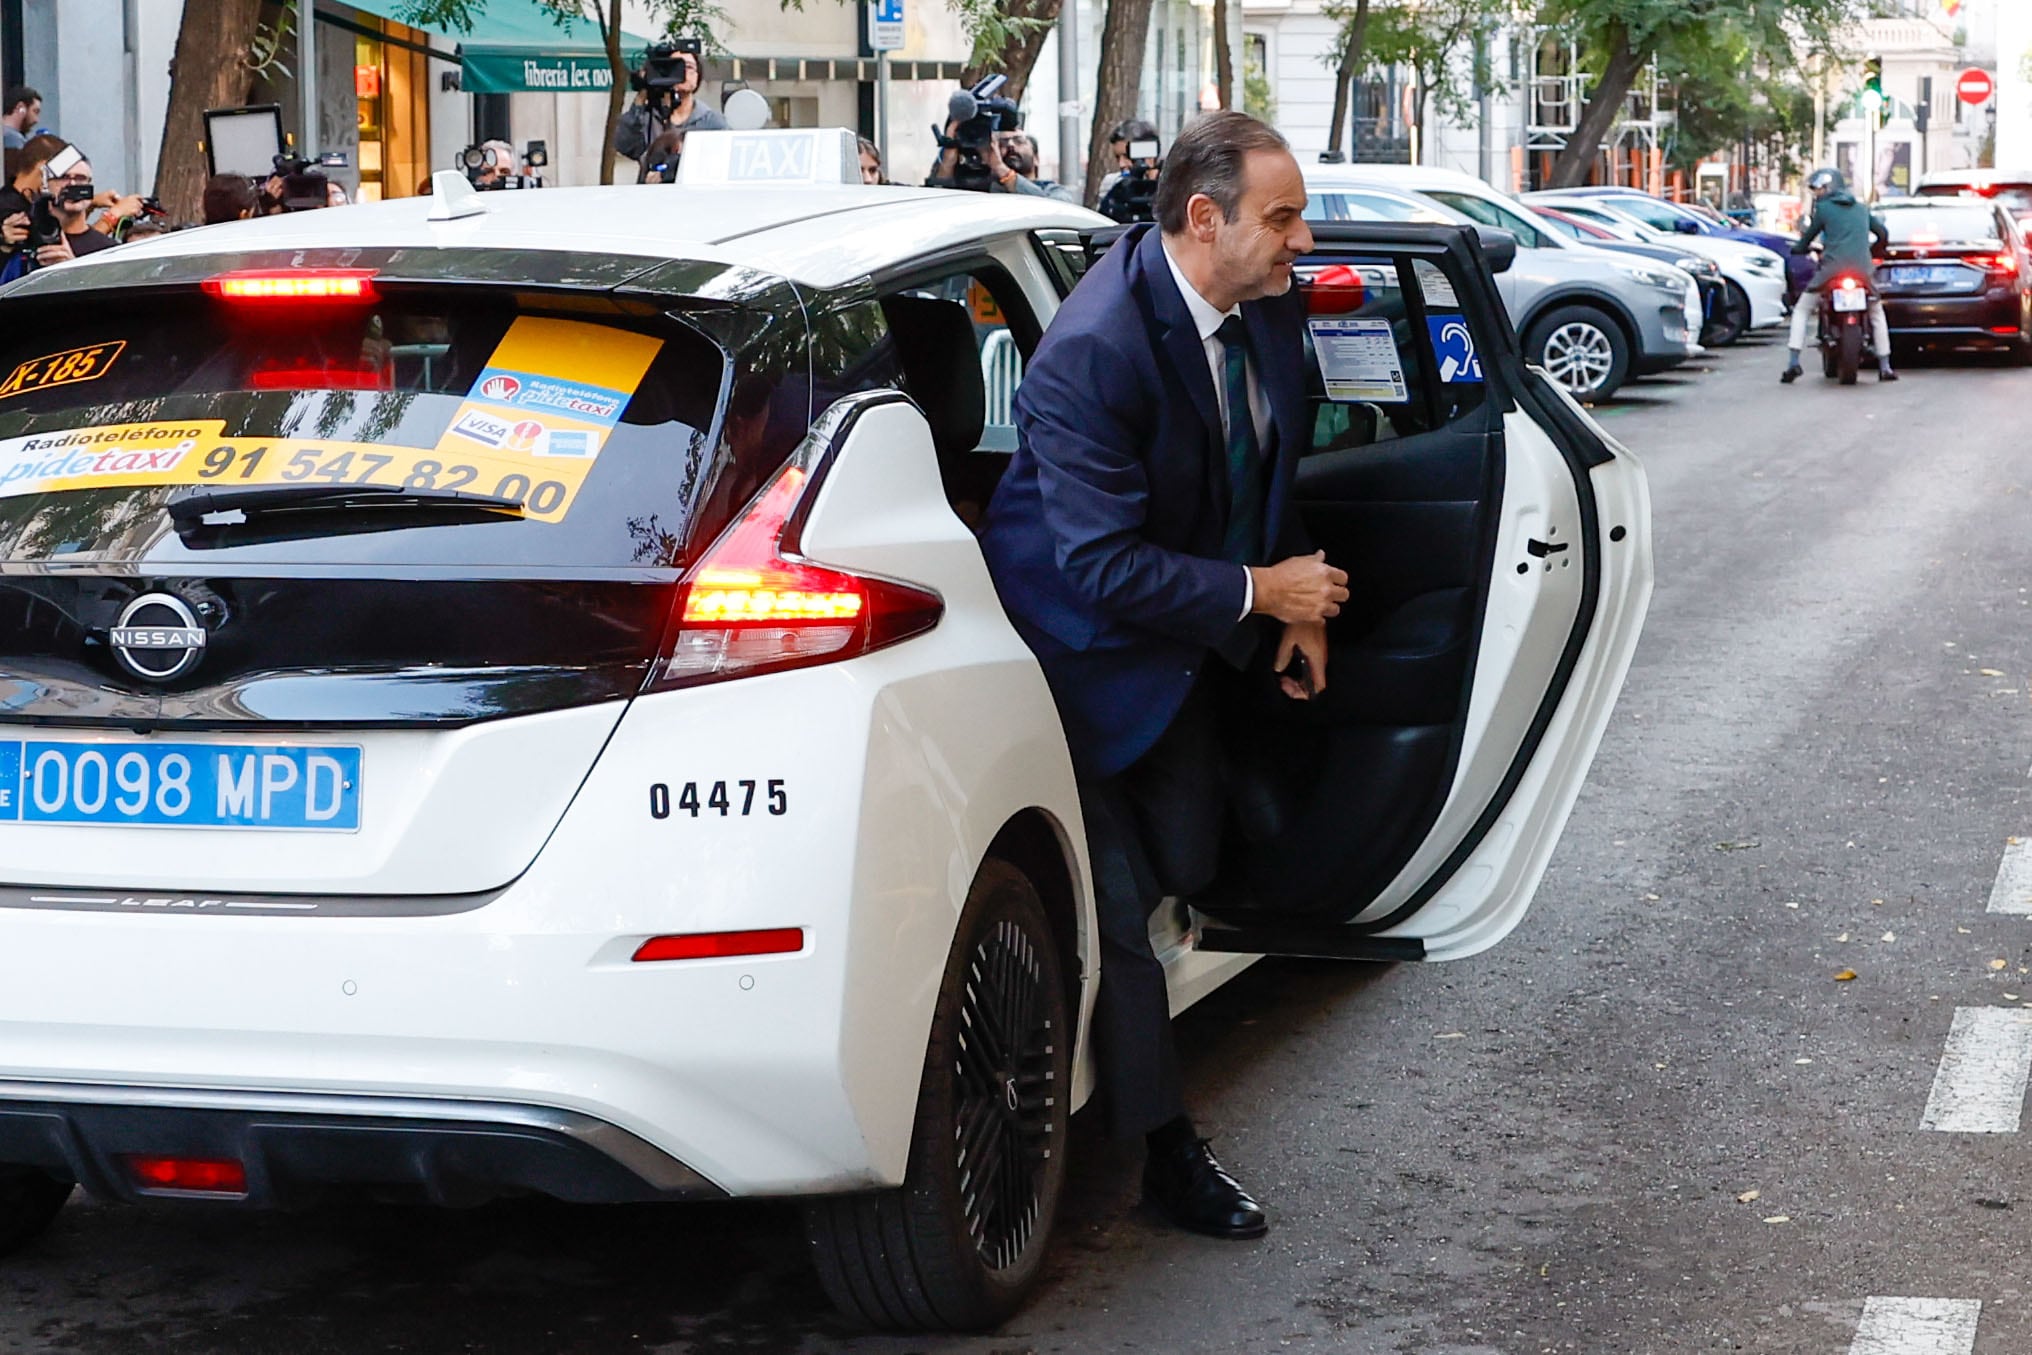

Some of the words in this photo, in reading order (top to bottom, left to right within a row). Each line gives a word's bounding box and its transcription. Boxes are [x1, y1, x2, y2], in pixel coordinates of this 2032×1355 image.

[571, 61, 591, 87] lex
[735, 139, 813, 177] TAXI
[0, 348, 104, 394] X-185
[22, 427, 202, 452] Radioteléfono
[469, 417, 508, 439] VISA
[0, 441, 192, 485] pidetaxi
[199, 446, 268, 480] 91
[281, 448, 393, 484] 547
[402, 459, 479, 490] 82
[493, 473, 567, 514] 00
[111, 631, 203, 645] NISSAN
[33, 750, 191, 817] 0098
[217, 754, 343, 821] MPD
[649, 779, 787, 819] 04475
[121, 898, 222, 908] LEAF
